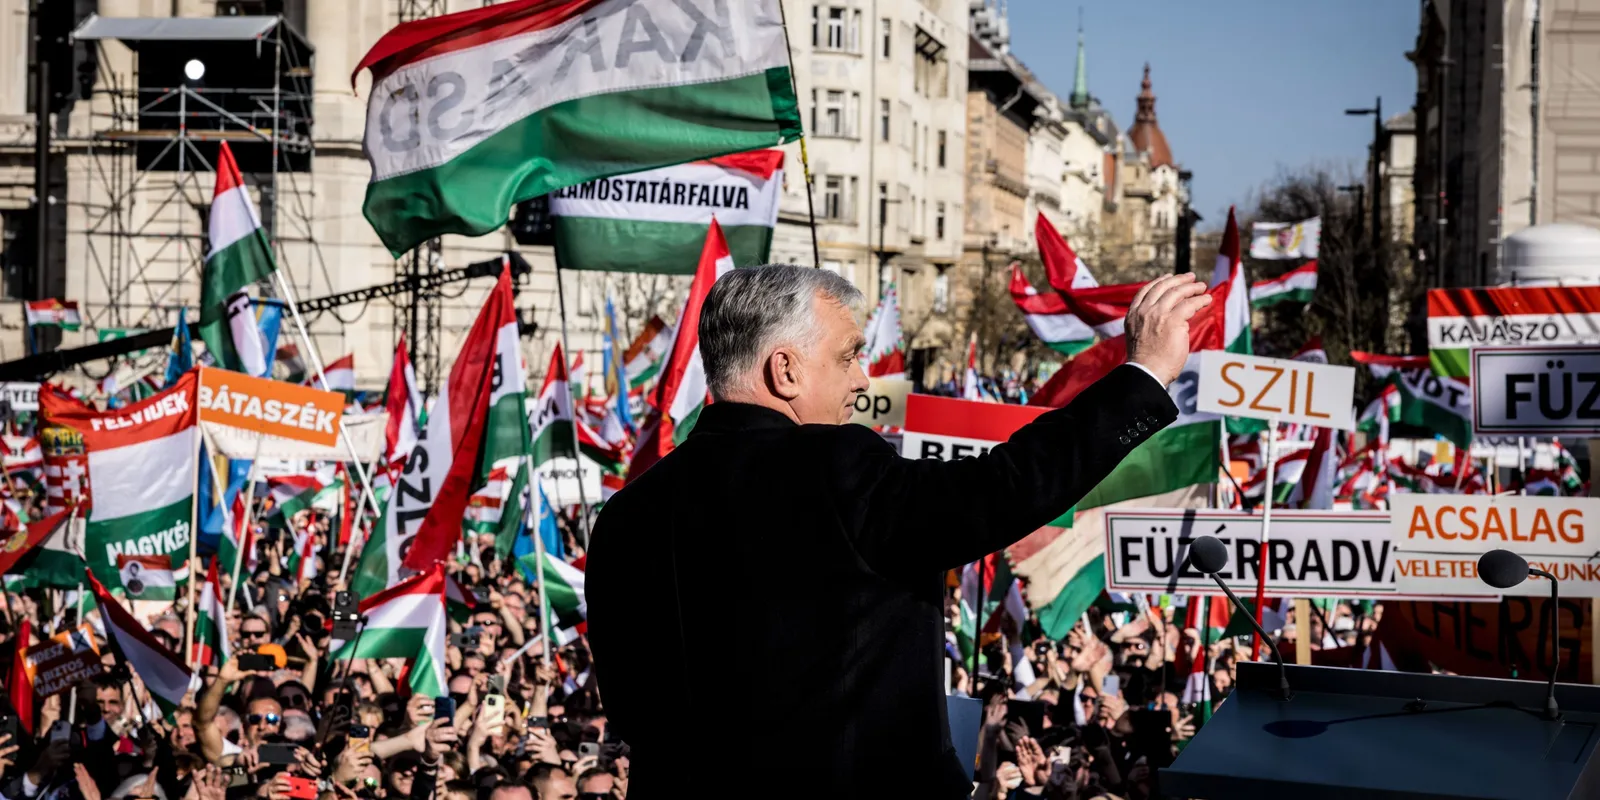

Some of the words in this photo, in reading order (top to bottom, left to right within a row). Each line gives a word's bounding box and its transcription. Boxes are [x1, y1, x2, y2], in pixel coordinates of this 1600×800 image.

[1440, 315, 1559, 343] KAJÁSZÓ
[200, 384, 336, 434] BÁTASZÉK
[1218, 361, 1330, 419] SZIL
[1506, 360, 1600, 420] FÜZ
[1408, 505, 1584, 543] ACSALAG
[1119, 524, 1396, 583] FÜZRRADV
